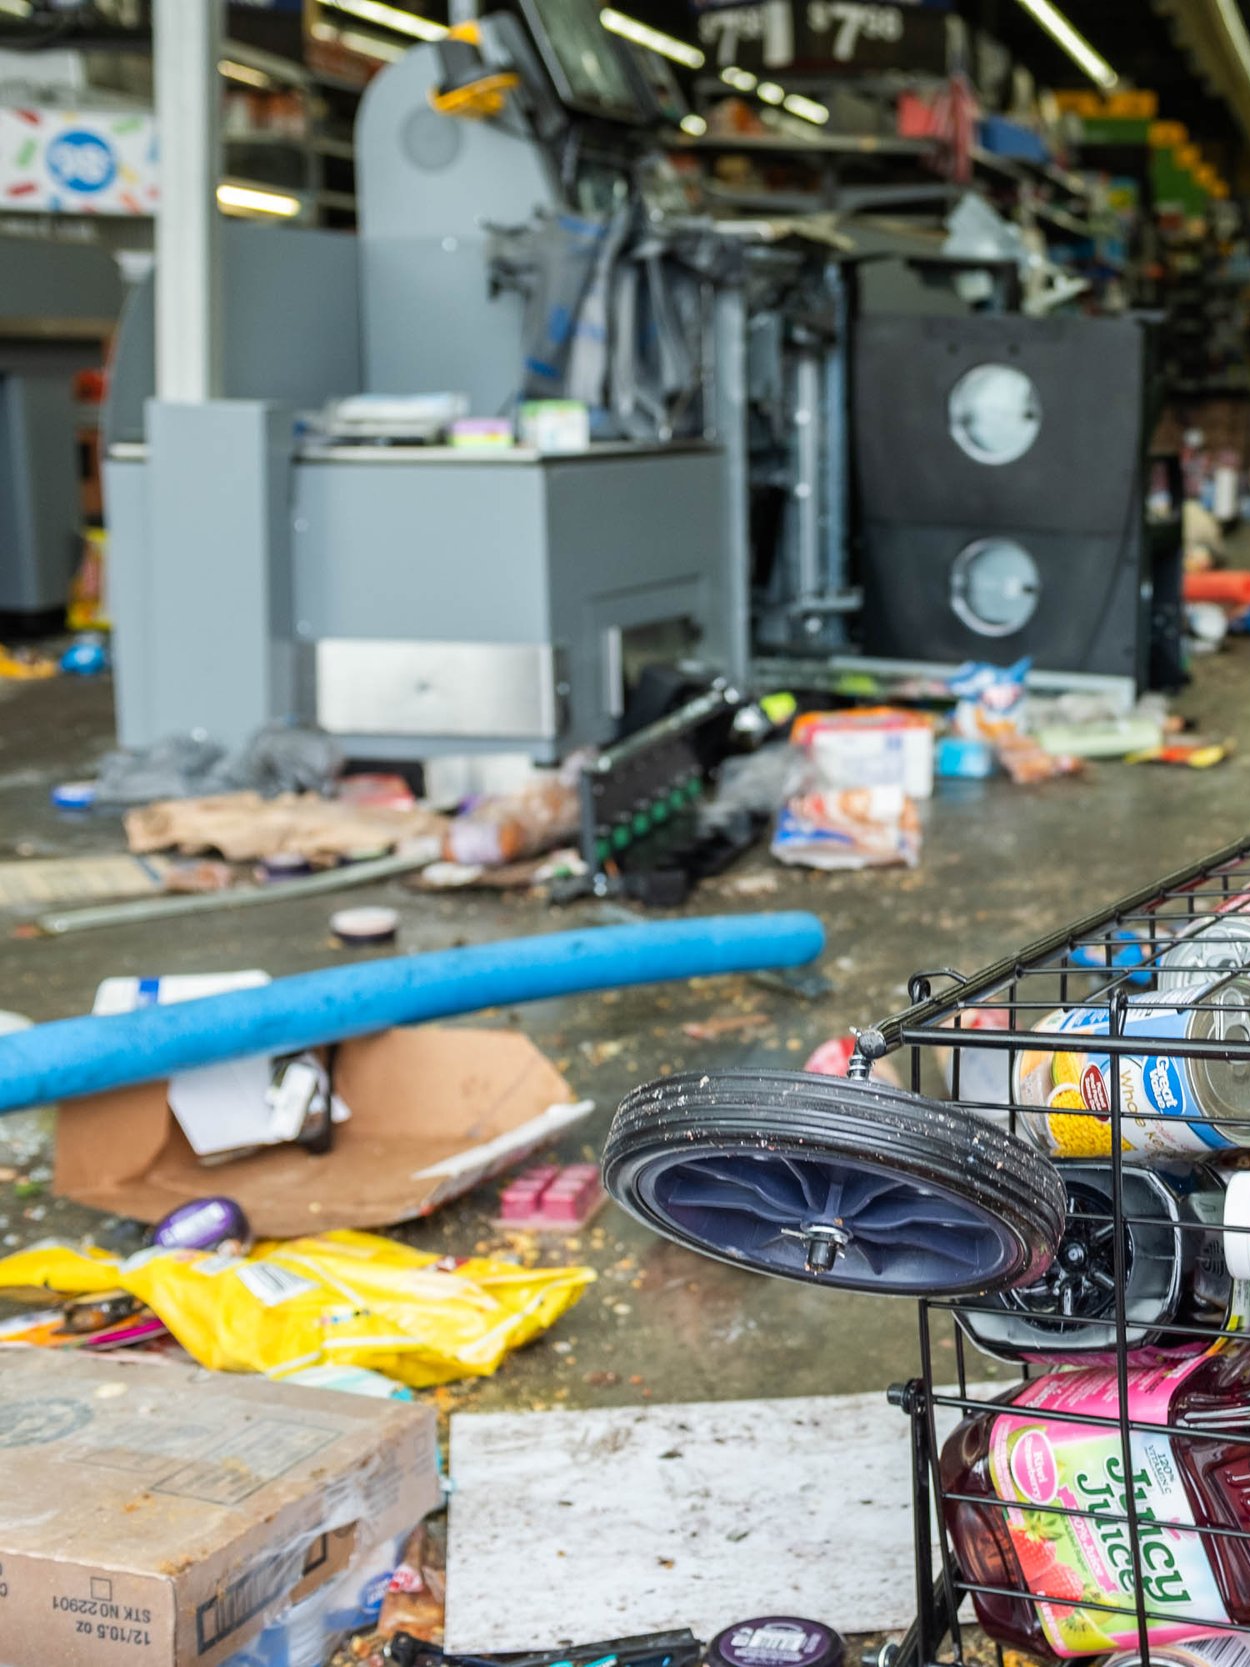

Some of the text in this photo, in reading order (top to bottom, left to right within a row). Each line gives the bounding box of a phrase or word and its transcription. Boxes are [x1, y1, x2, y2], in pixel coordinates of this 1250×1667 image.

[1120, 1069, 1146, 1127] Whoe
[1148, 1067, 1165, 1109] Value
[1155, 1055, 1178, 1109] Great
[1033, 1451, 1048, 1483] Kiwi
[1147, 1445, 1168, 1485] VITAMIN
[1157, 1453, 1175, 1483] 120%
[1077, 1474, 1135, 1592] Juice
[1106, 1457, 1191, 1602] Juicy
[1083, 1542, 1104, 1577] Juice
[52, 1596, 97, 1616] 22901
[124, 1610, 151, 1623] STK
[76, 1621, 151, 1645] 12/10.5 oz
